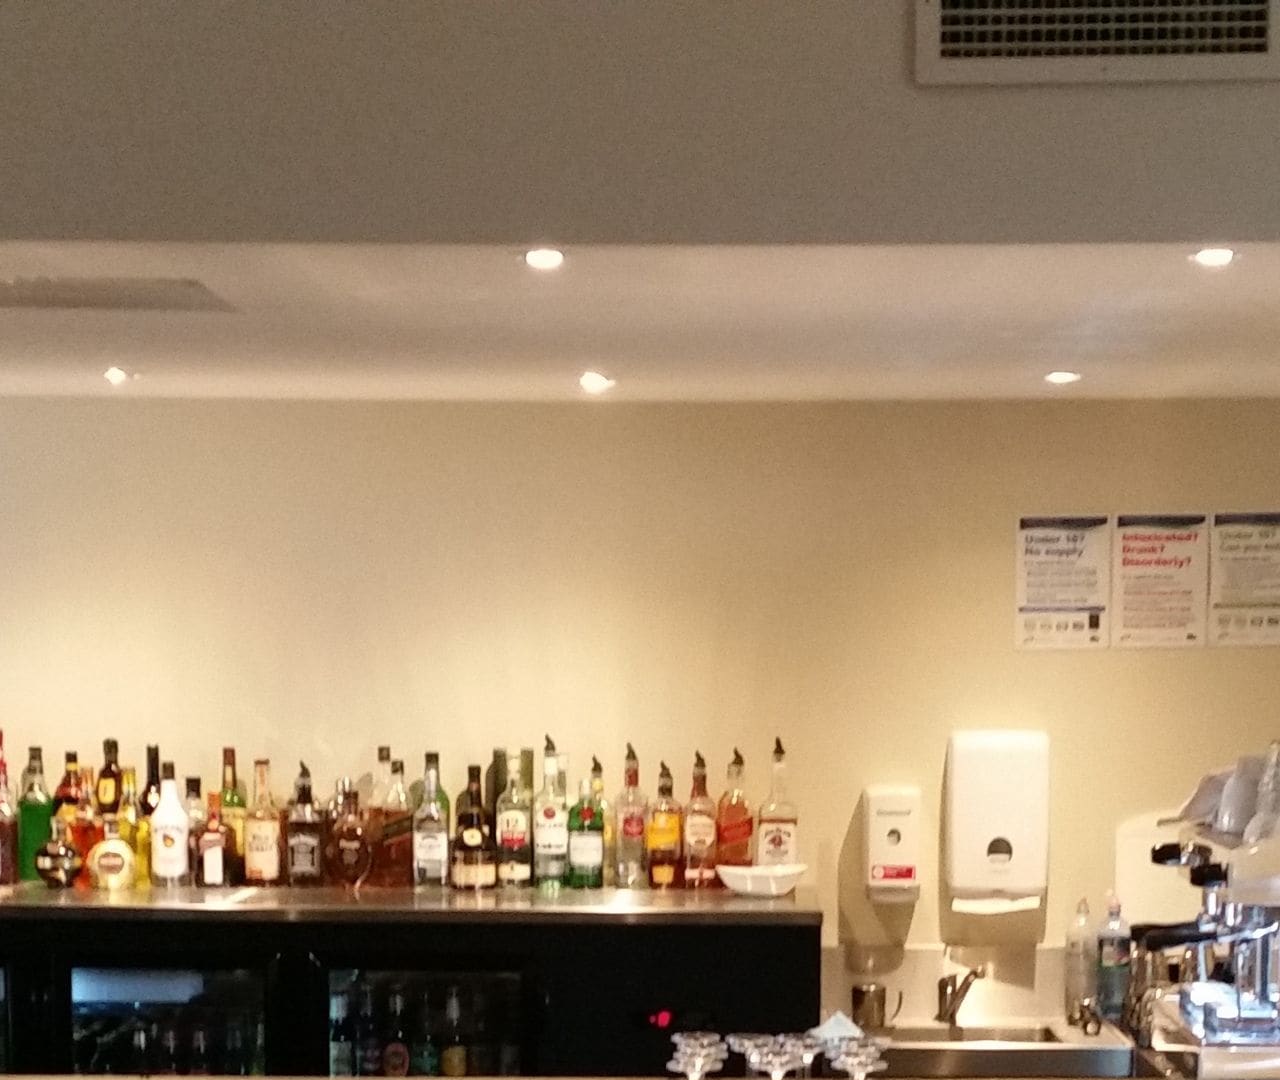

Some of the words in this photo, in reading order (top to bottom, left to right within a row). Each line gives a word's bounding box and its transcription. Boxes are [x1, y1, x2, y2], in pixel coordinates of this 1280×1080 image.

[1024, 534, 1060, 544] Under
[1122, 532, 1199, 542] Intoxicated?
[1024, 547, 1041, 555] No
[1045, 546, 1084, 558] supply
[1122, 544, 1166, 554] Drunk?
[1122, 555, 1192, 569] Disorderly?
